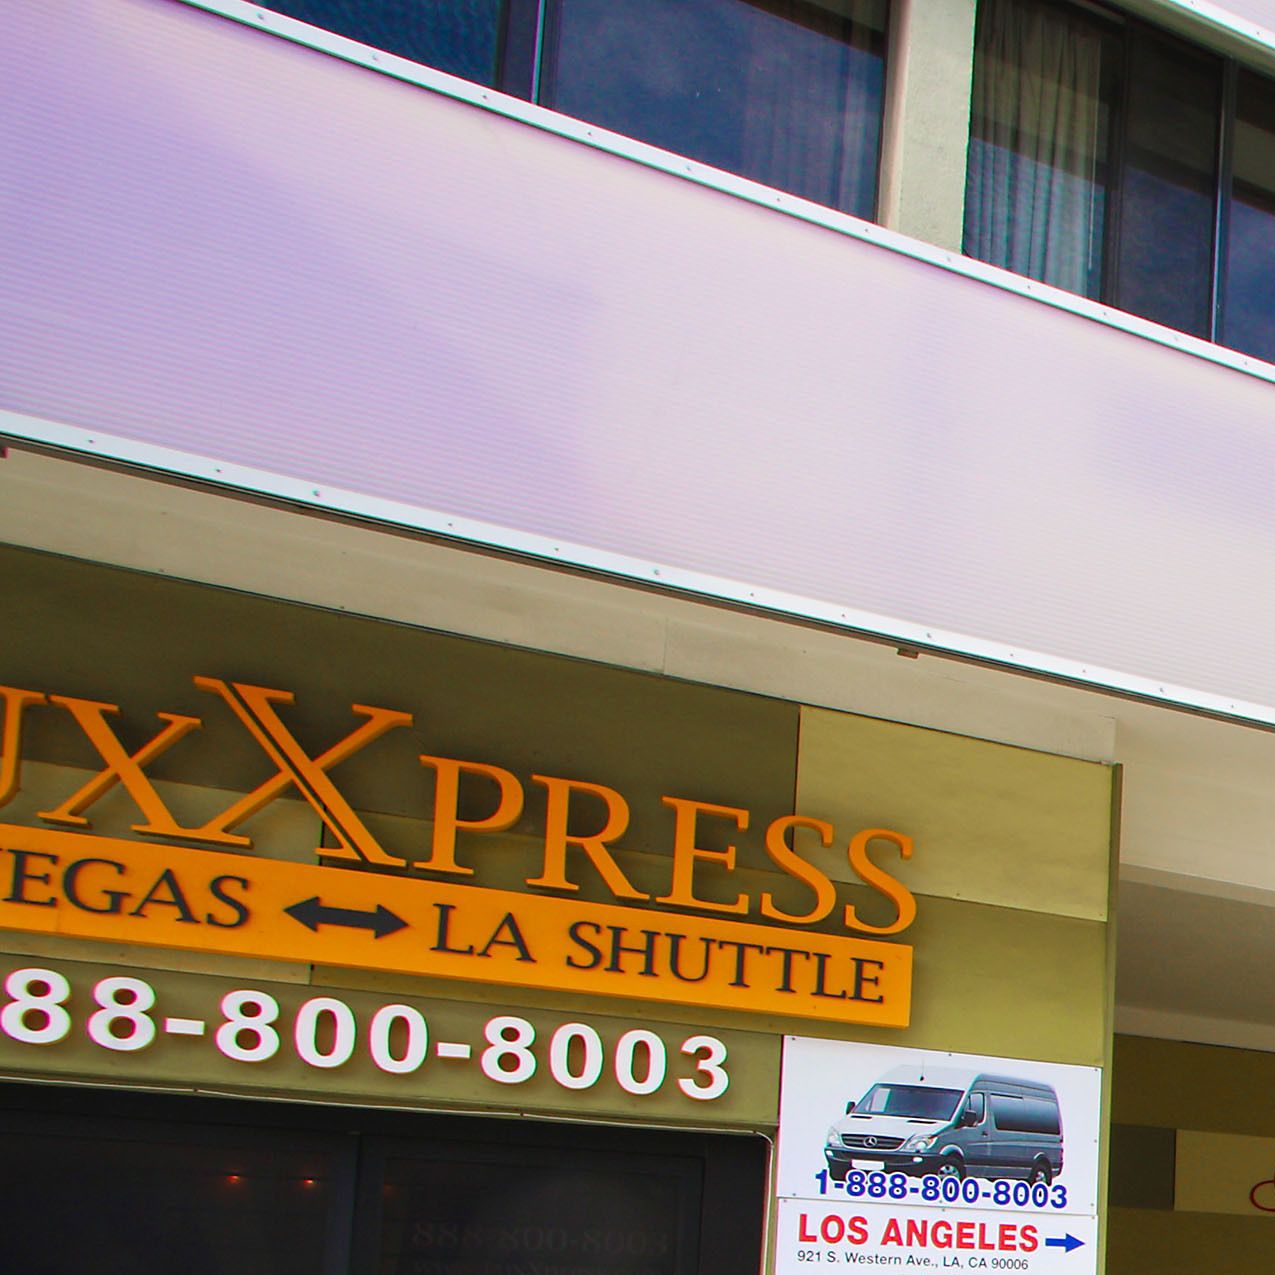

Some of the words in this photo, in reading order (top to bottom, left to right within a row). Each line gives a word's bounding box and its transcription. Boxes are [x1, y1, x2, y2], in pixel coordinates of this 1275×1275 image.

[0, 848, 250, 928] EGAS
[430, 903, 537, 963] LA
[566, 920, 885, 1004] SHUTTLE
[0, 968, 730, 1100] 88-800-8003
[815, 1168, 1068, 1209] 1-888-800-8003
[798, 1213, 869, 1245] LOS
[880, 1218, 1039, 1253] ANGELES
[797, 1250, 821, 1262] 921
[827, 1252, 840, 1263] S.
[845, 1252, 902, 1265] Western
[906, 1255, 938, 1268] Ave.,
[943, 1257, 964, 1269] LA,
[968, 1257, 987, 1268] CA
[991, 1258, 1029, 1270] 90006
